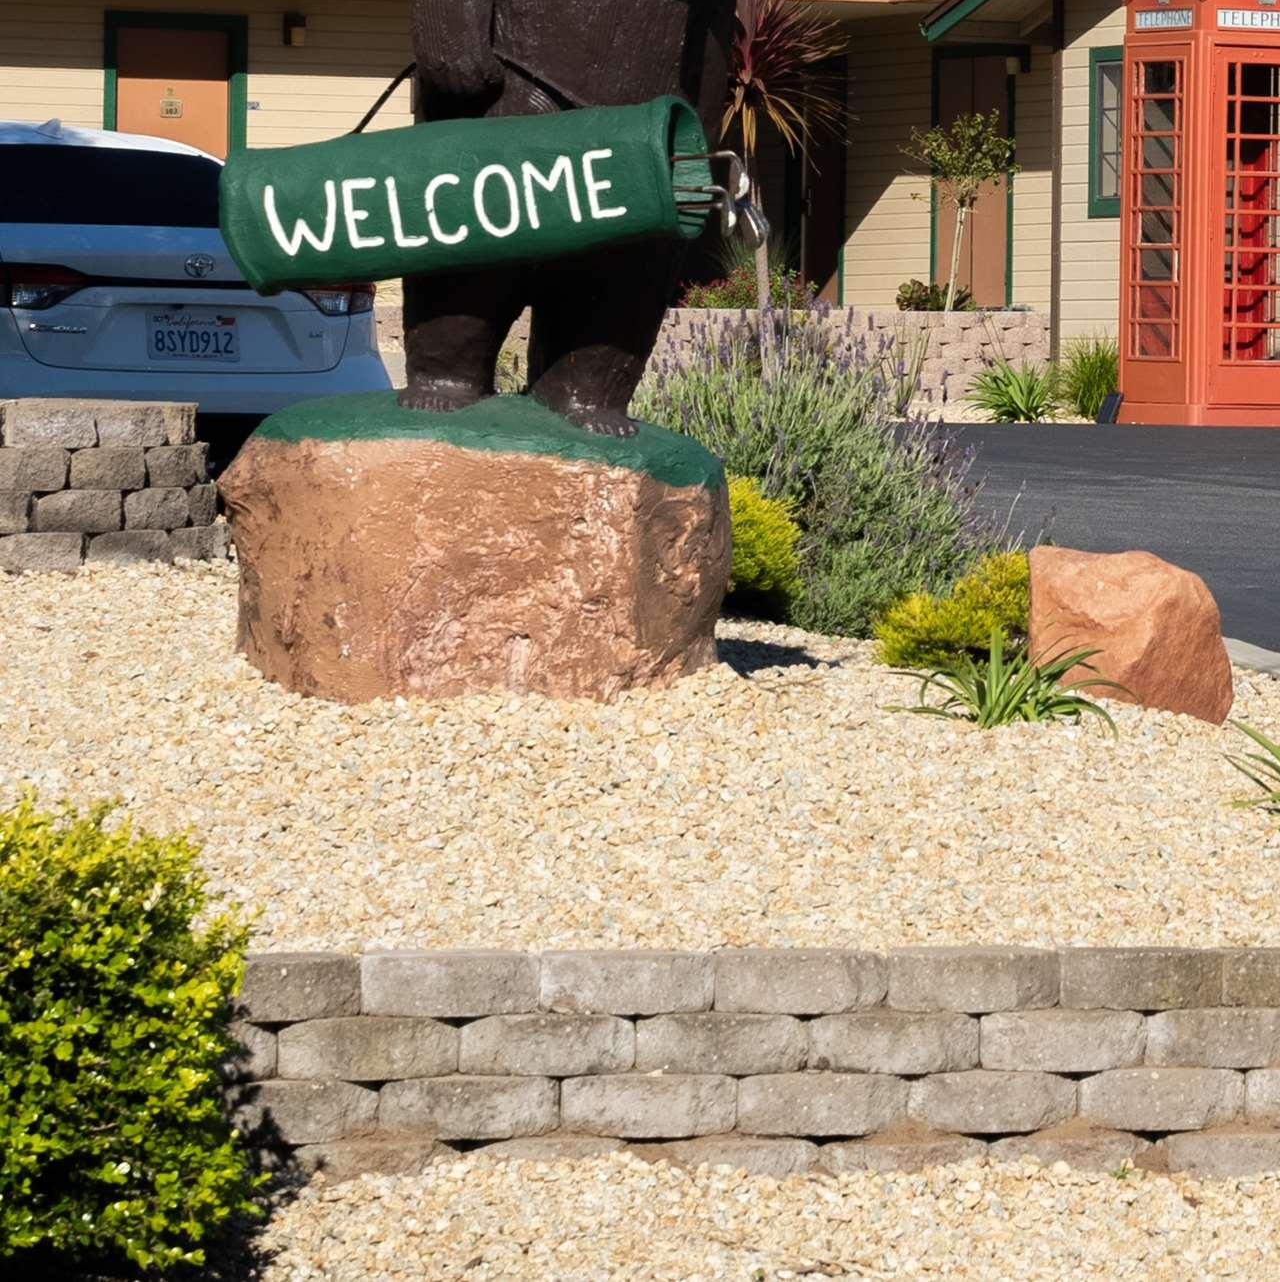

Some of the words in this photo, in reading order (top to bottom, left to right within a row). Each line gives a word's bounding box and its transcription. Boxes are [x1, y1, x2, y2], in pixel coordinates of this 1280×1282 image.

[1138, 9, 1190, 27] TELEPHONE
[264, 148, 627, 257] WELCOME
[154, 329, 235, 354] 8SYD912
